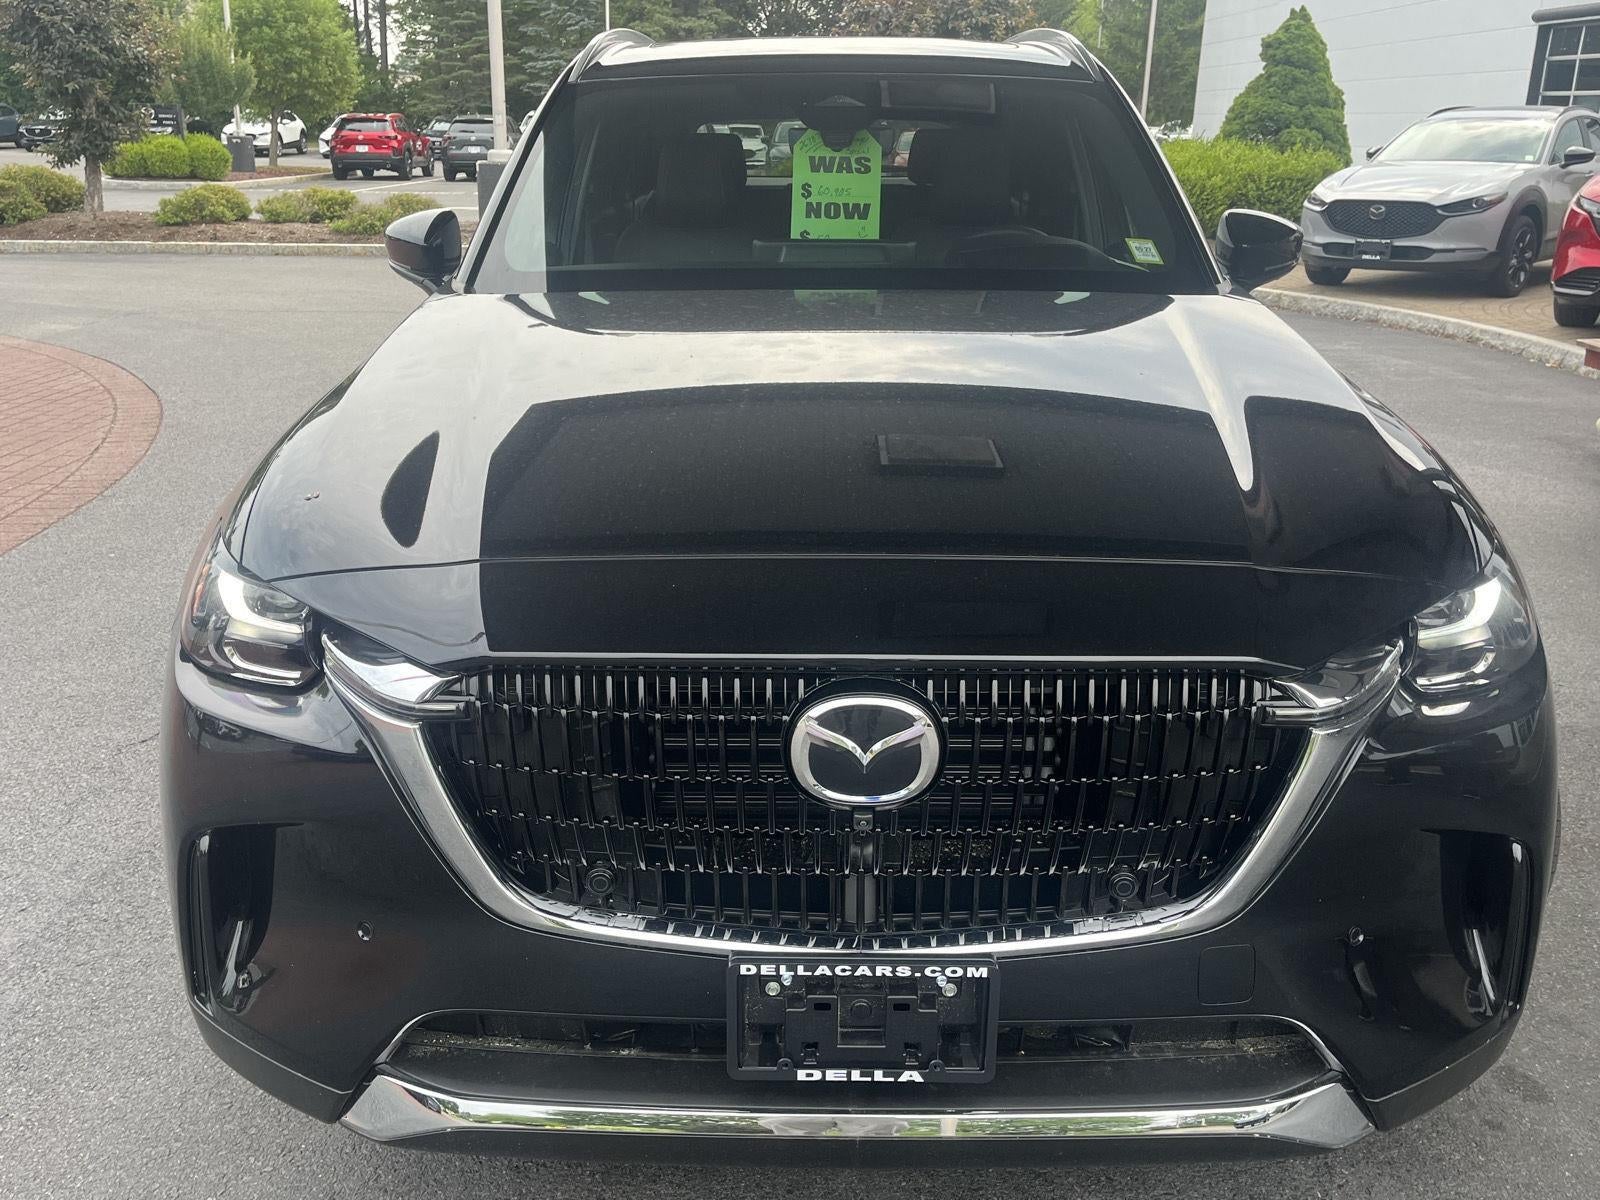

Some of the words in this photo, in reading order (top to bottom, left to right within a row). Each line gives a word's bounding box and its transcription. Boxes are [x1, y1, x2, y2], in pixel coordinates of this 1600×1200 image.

[809, 156, 872, 174] WAS
[801, 182, 812, 200] $
[805, 202, 871, 220] NOW
[740, 964, 988, 978] DELLACARS.COM
[796, 1070, 925, 1083] DELLA
